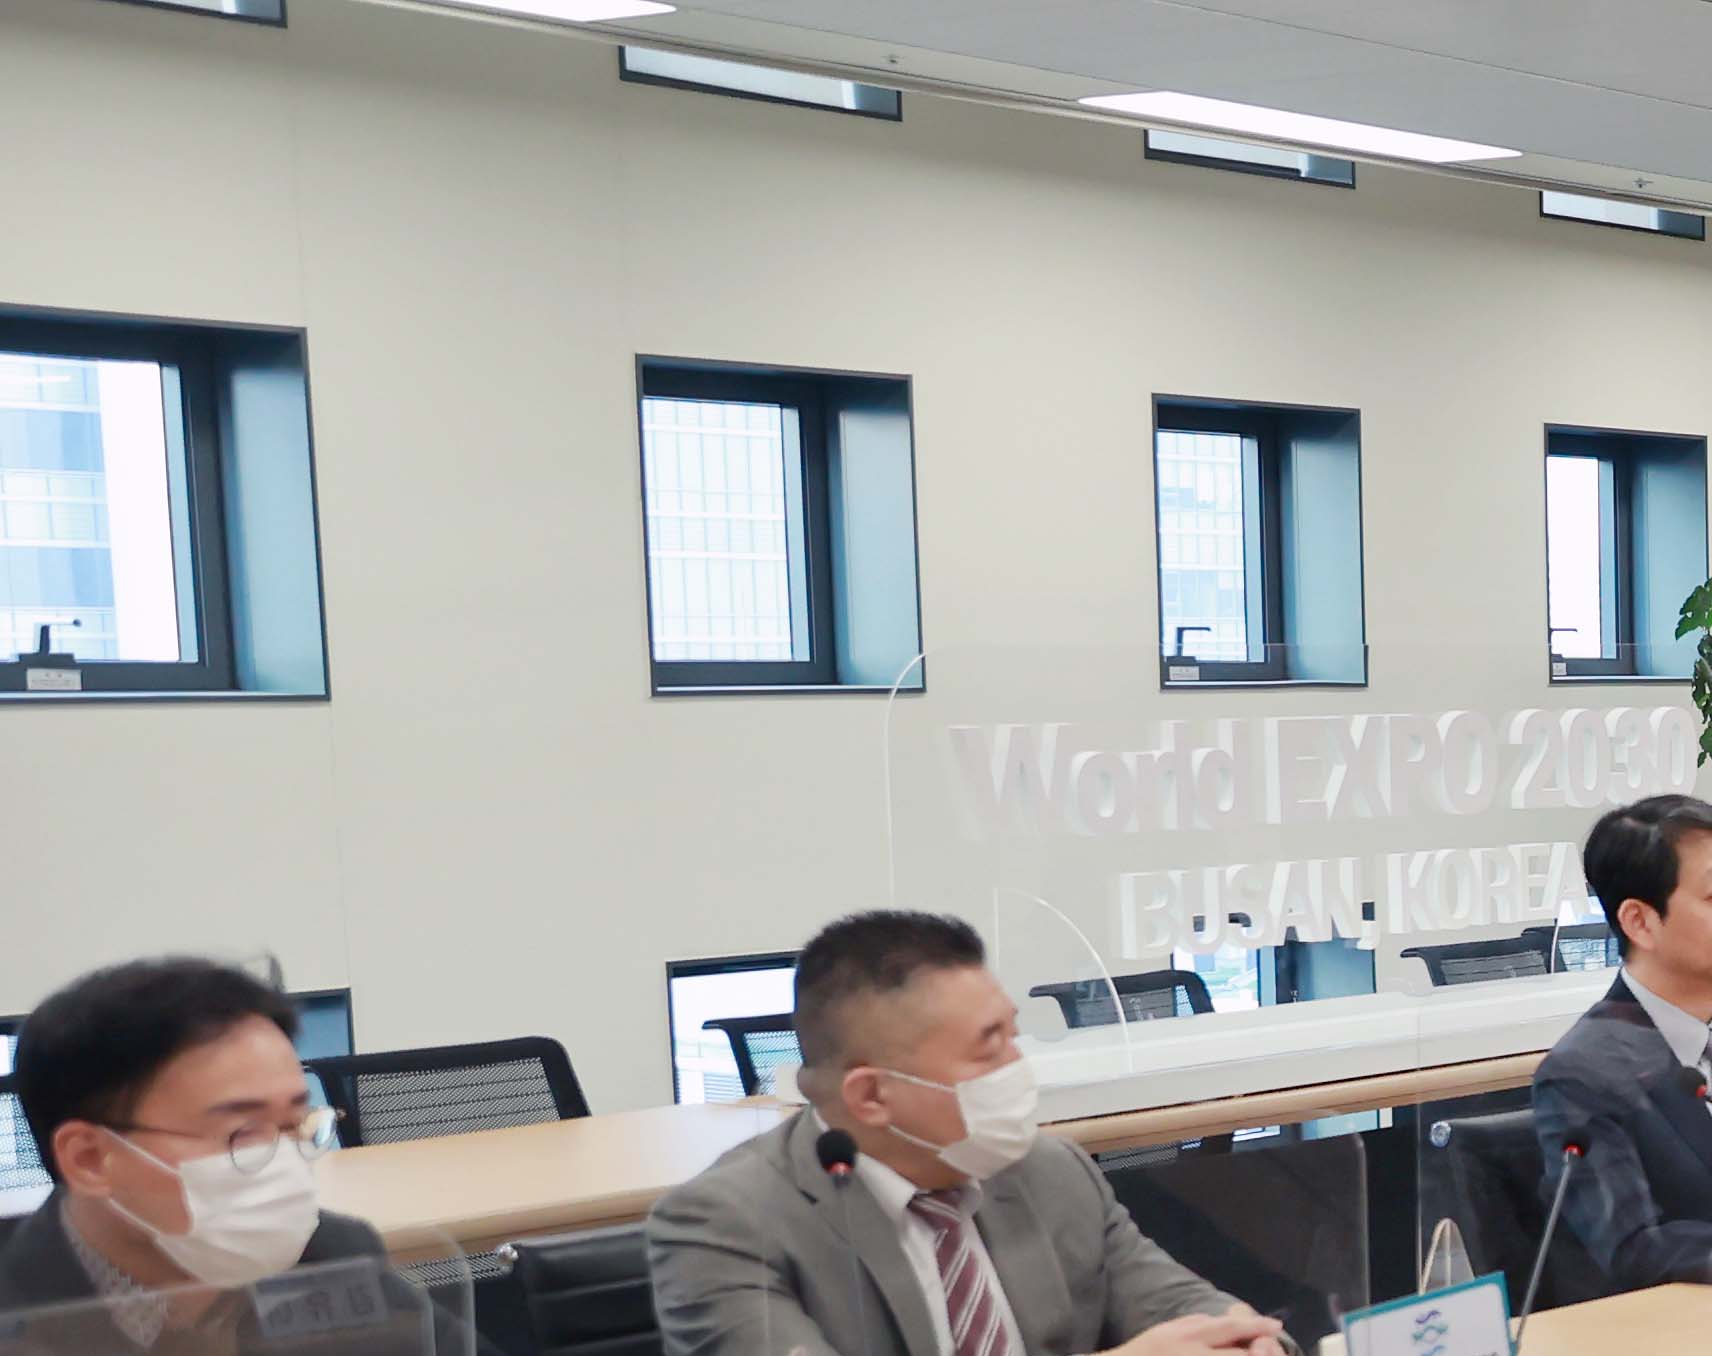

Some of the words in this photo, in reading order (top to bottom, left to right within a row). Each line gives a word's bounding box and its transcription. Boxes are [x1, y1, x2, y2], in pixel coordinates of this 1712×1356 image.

[950, 717, 1240, 842] World
[1264, 709, 1497, 828] EXPO
[1508, 704, 1698, 814] 2030
[1118, 856, 1381, 962] BUSAN,
[1388, 840, 1600, 936] KOREA
